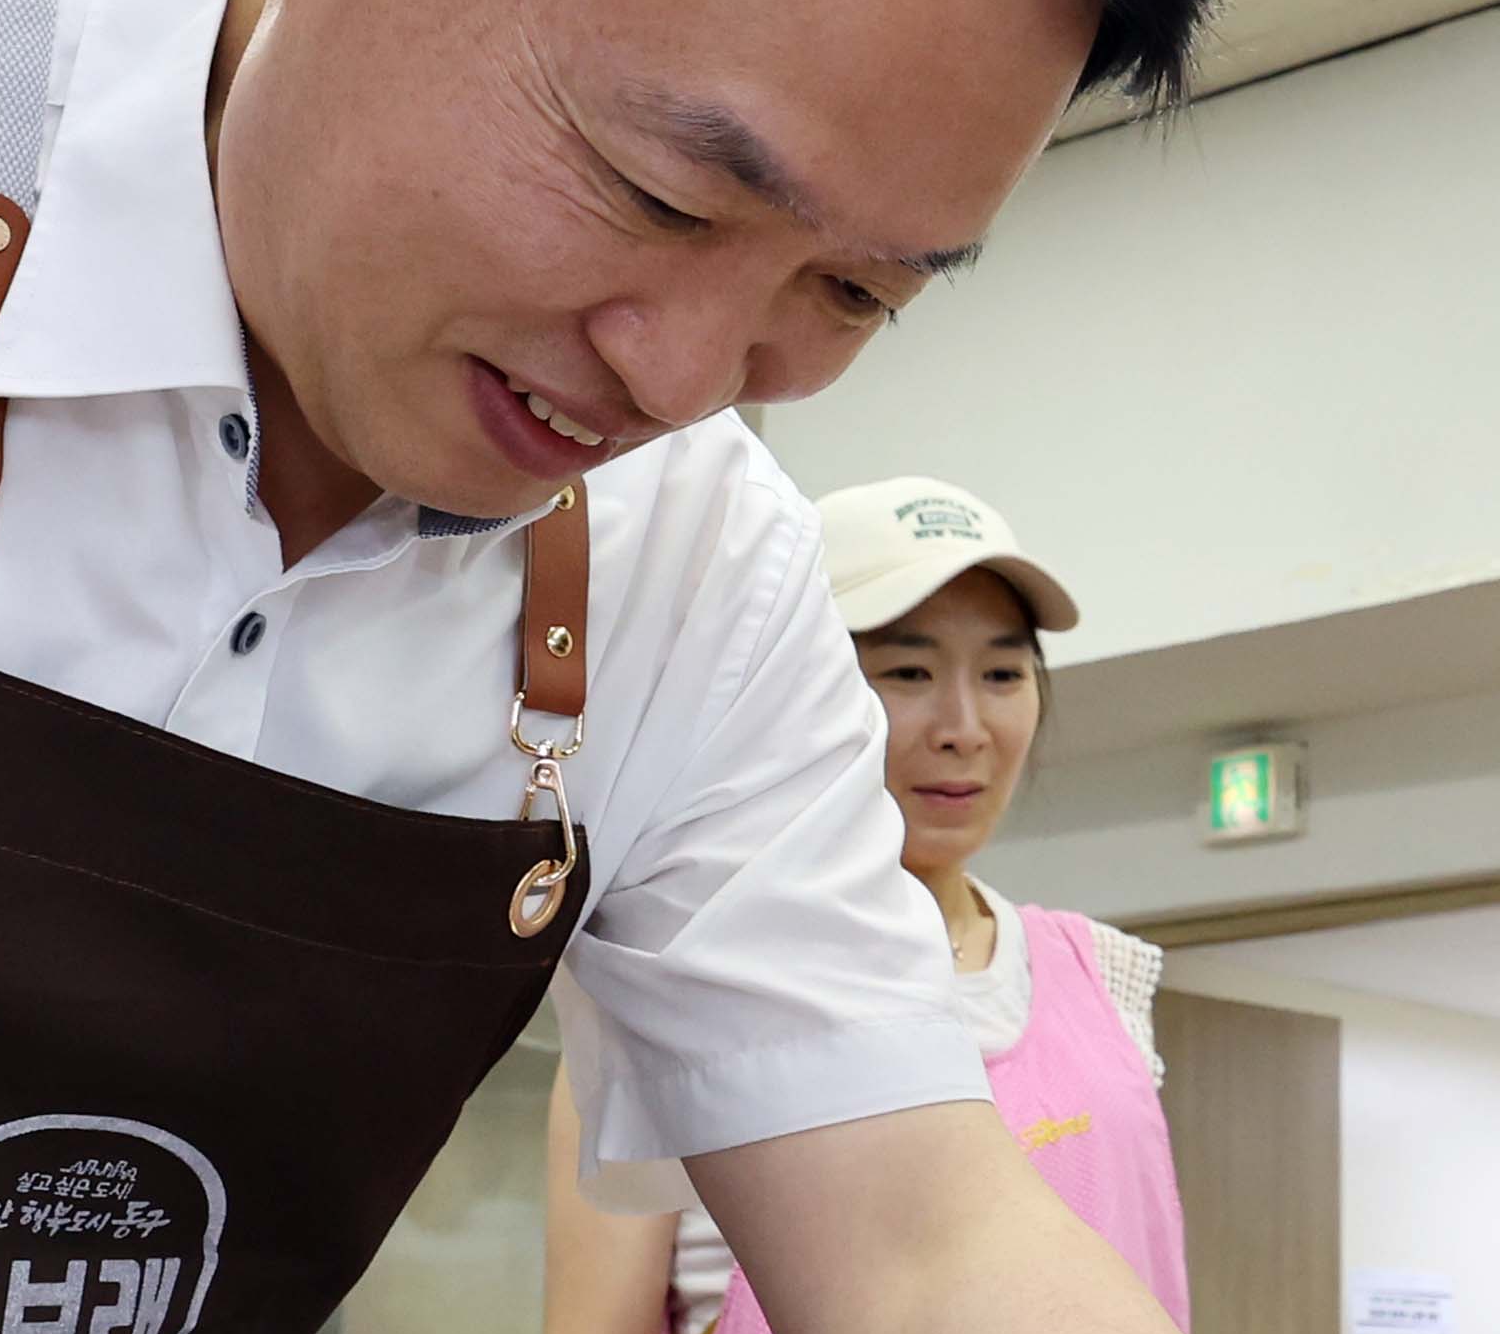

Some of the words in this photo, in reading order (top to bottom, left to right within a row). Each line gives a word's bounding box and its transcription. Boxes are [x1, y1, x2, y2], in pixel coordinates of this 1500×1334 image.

[15, 1172, 52, 1193] 살고
[53, 1175, 91, 1198] 싶은
[18, 1200, 112, 1237] 행복도시
[111, 1201, 172, 1239] 동구
